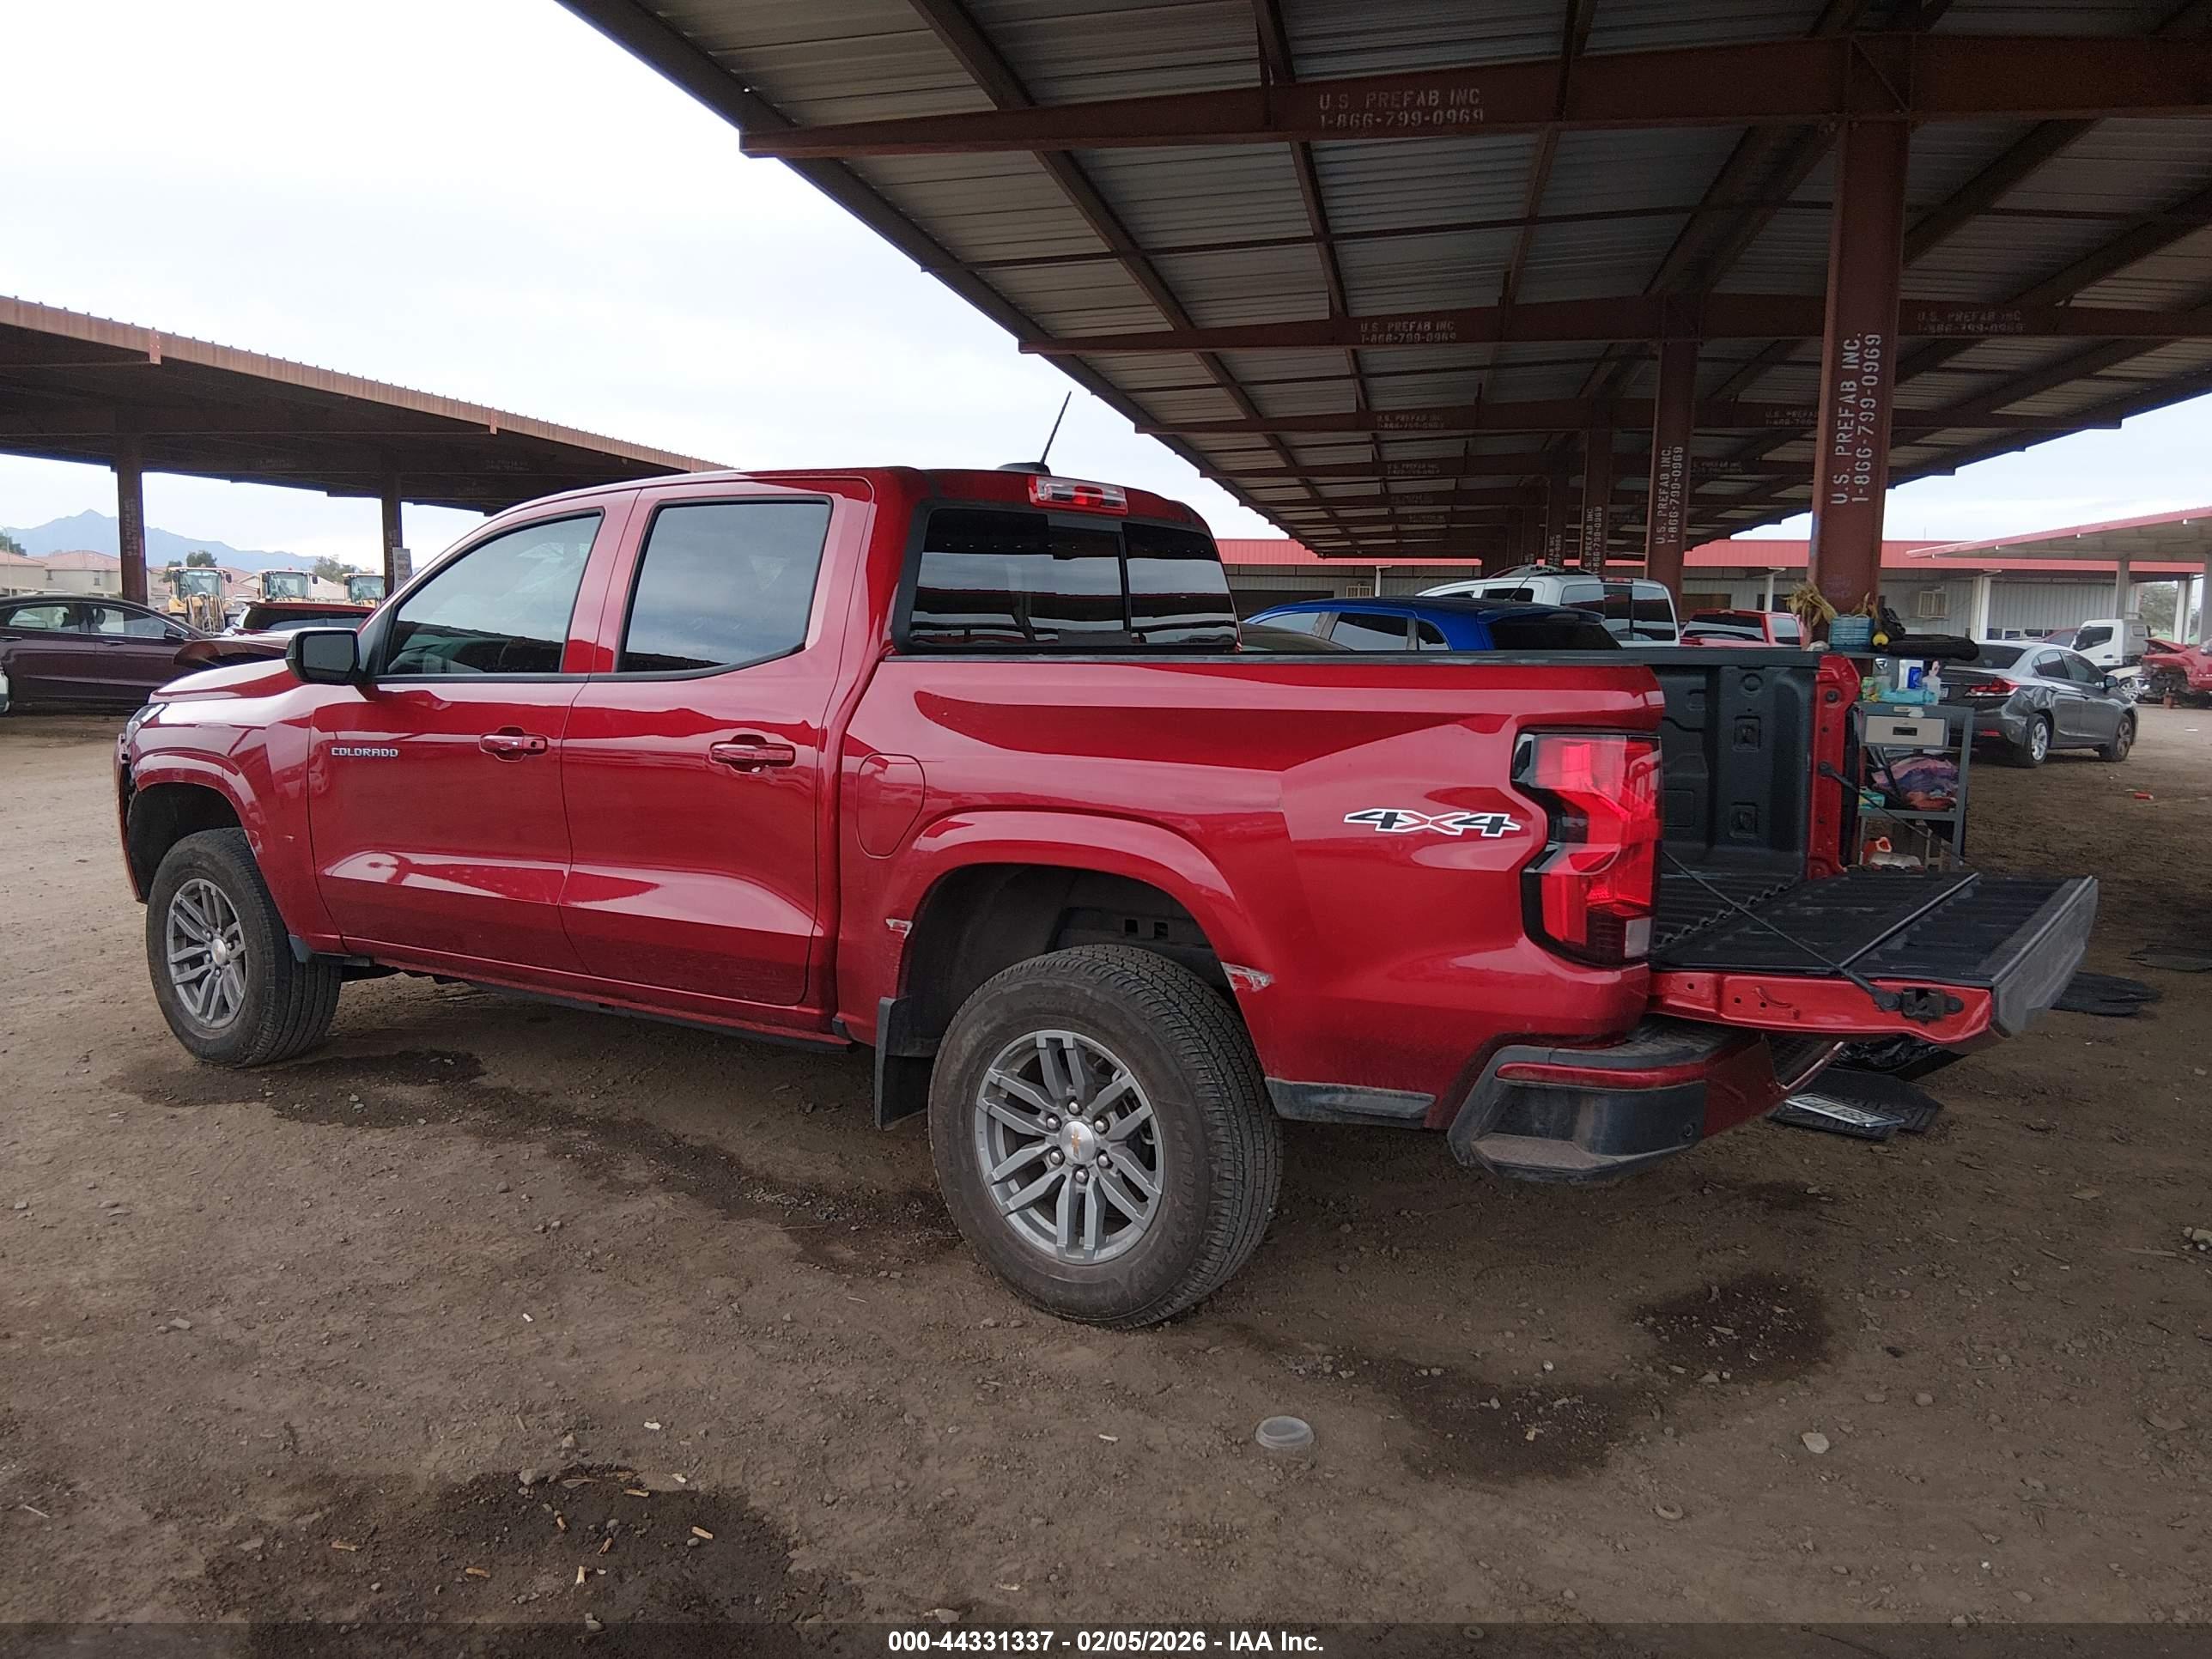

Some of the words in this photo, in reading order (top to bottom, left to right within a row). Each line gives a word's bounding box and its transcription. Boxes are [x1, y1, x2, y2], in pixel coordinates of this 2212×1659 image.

[1365, 89, 1439, 109] PREFAB
[1387, 321, 1431, 332] PREFAB
[1841, 332, 1861, 369] INC.
[1834, 380, 1857, 456] PREFAB
[1851, 333, 1881, 502] 1-866-799-0969
[1657, 472, 1670, 517] PREFAB
[1667, 446, 1684, 544] 1-866-799-0969
[1831, 467, 1850, 504] U.S.
[331, 747, 398, 757] COLORADO
